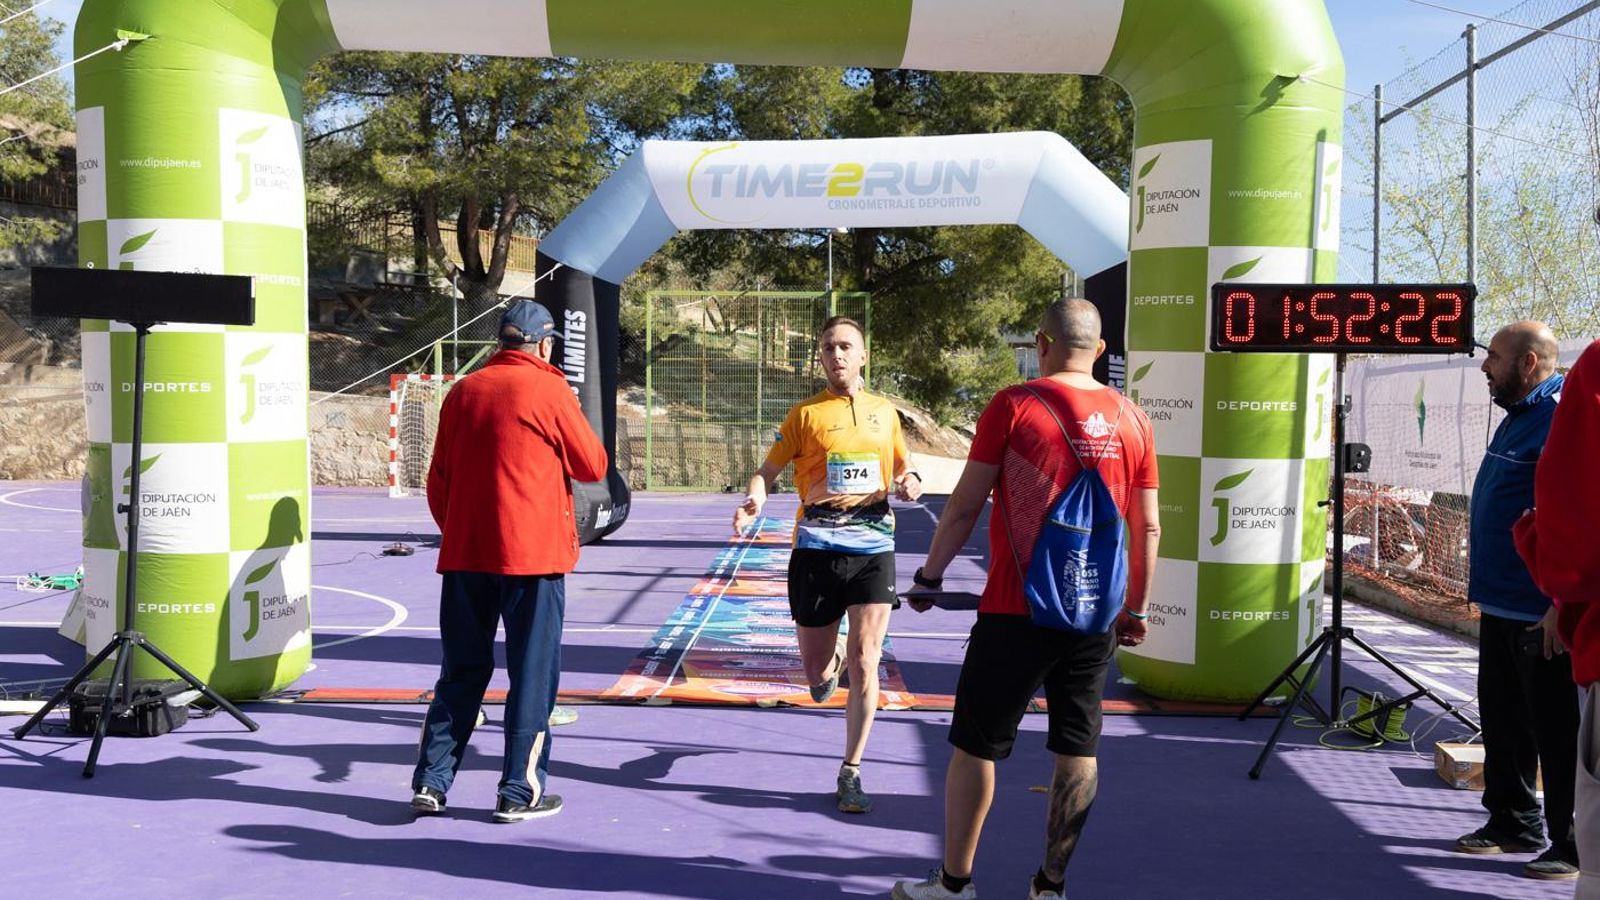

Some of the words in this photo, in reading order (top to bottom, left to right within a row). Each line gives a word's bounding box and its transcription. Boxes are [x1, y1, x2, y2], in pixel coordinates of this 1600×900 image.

[119, 157, 202, 169] www.dipujaen.es
[703, 159, 981, 198] TIME2RUN
[1146, 188, 1200, 201] DIPUTACIÓN
[827, 199, 915, 211] CRONOMETRAJE
[918, 196, 982, 209] DEPORTIVO
[1146, 204, 1156, 214] DE
[1156, 202, 1179, 214] JAÉN
[1134, 295, 1194, 305] DEPORTES
[1226, 292, 1462, 342] 01:52:22
[558, 309, 586, 383] LÍMITES
[1140, 397, 1193, 409] DIPUTACIÓN
[1216, 401, 1297, 411] DEPORTES
[1150, 410, 1172, 421] JAÉN
[843, 468, 868, 480] 374
[142, 491, 216, 503] DIPUTACIÓN
[143, 507, 158, 517] DE
[160, 506, 191, 517] JAÉN
[1232, 506, 1296, 516] DIPUTACIÓN
[1232, 520, 1248, 529] DE
[1249, 518, 1276, 529] JAÉN
[137, 602, 216, 614] EPORTES
[263, 611, 276, 620] DE
[277, 605, 296, 618] JAÉN
[1147, 602, 1187, 616] UTACIÓN
[1147, 615, 1166, 627] AÉN
[1210, 610, 1290, 621] DEPORTES
